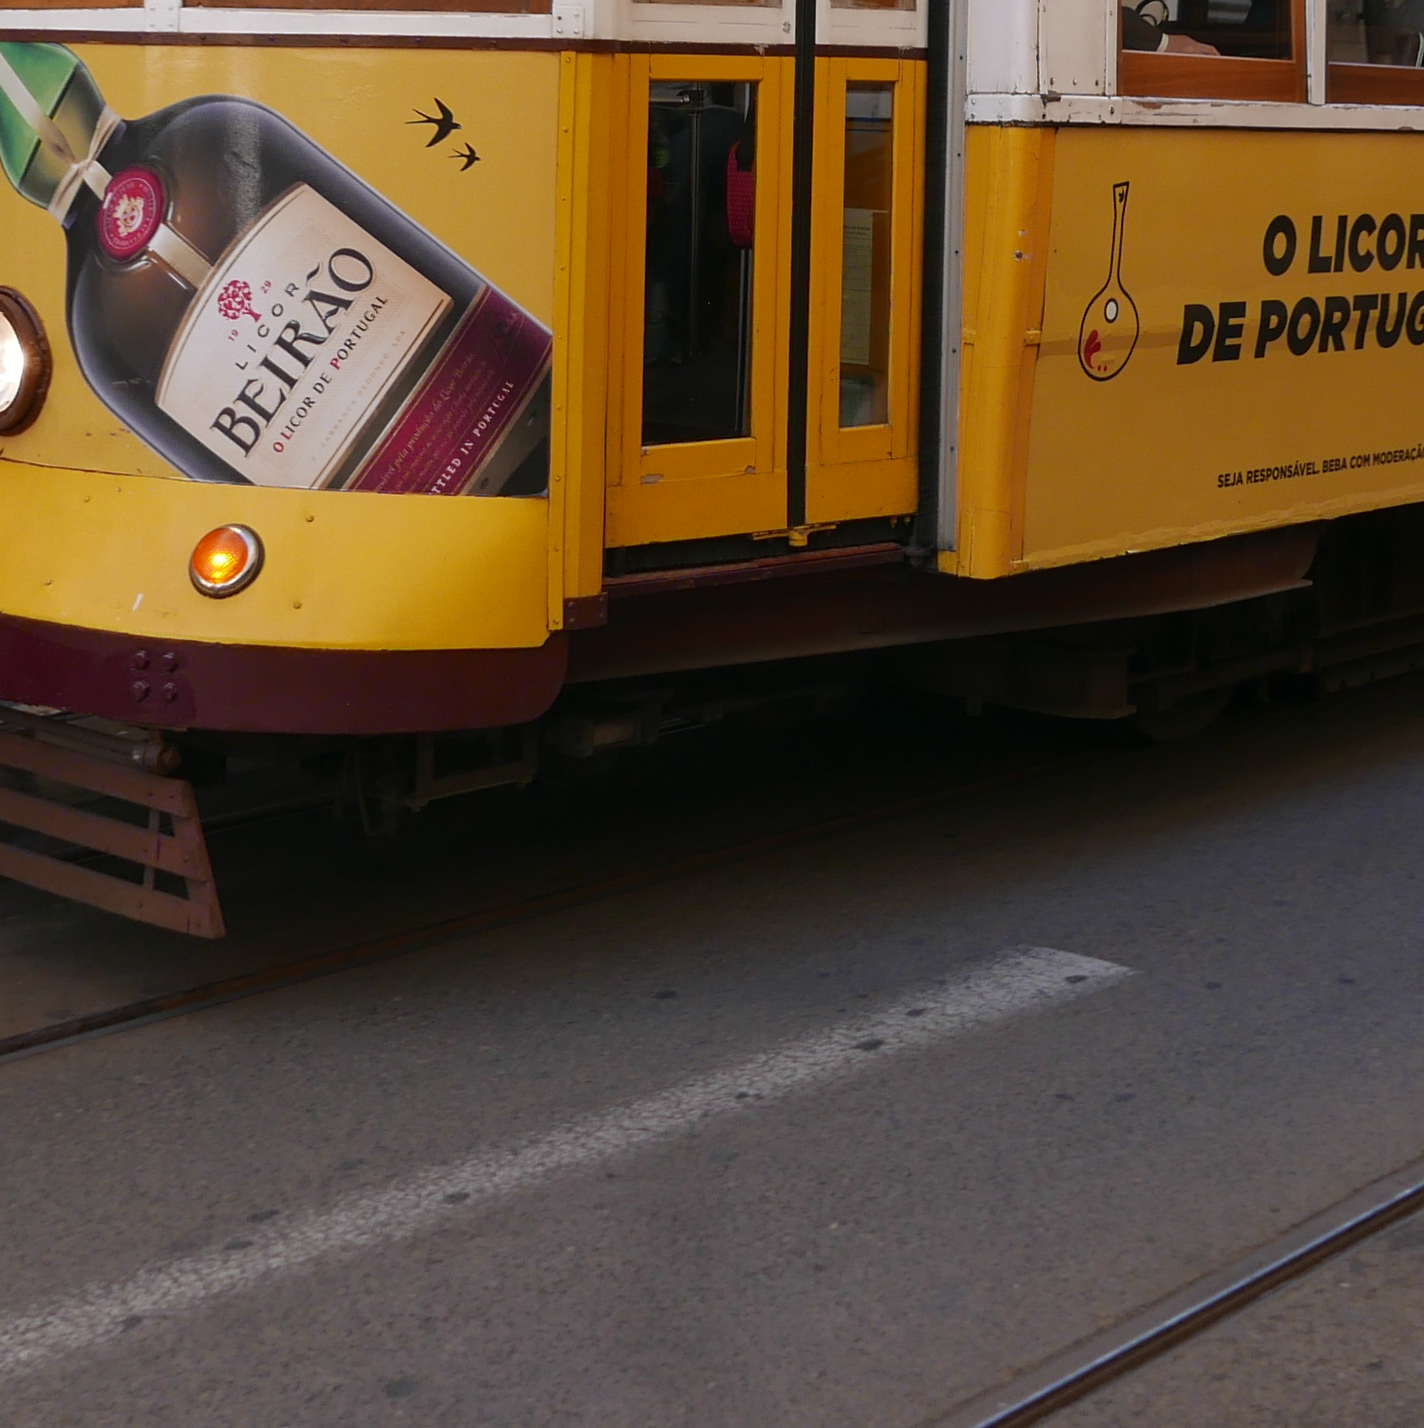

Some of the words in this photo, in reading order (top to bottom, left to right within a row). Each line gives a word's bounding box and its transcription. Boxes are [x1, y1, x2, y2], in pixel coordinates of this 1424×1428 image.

[1263, 215, 1297, 277] O
[210, 248, 374, 458] BEIRÃO
[235, 282, 300, 371] LICOR
[1176, 301, 1247, 365] DE
[273, 441, 284, 453] O
[280, 396, 316, 441] LICOR
[313, 372, 332, 394] DE
[330, 295, 388, 370] PORTUGAL
[429, 458, 461, 494] TTLED
[460, 440, 474, 455] IN
[1217, 473, 1243, 489] SEJA
[1246, 460, 1320, 484] RESPONSÁVEL.
[1322, 457, 1348, 474] BEBA
[1350, 453, 1371, 469] COM
